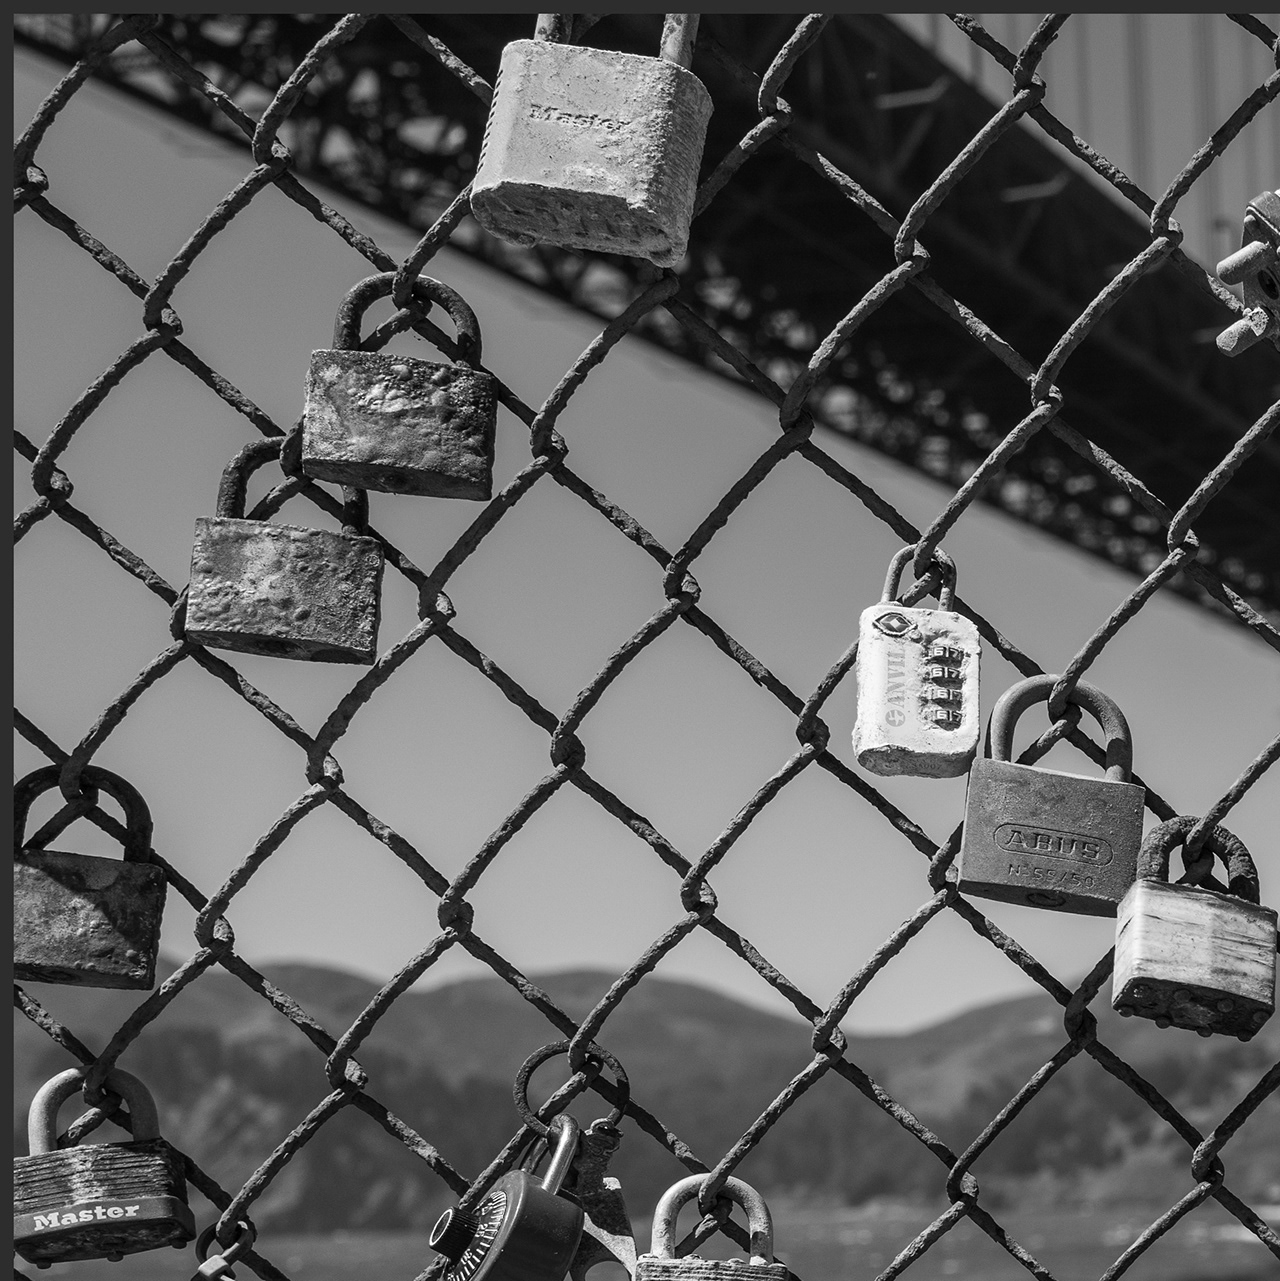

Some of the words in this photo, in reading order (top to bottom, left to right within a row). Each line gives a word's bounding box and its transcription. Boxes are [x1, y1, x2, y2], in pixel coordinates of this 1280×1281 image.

[529, 103, 632, 131] Master
[1005, 829, 1101, 860] ABUS
[33, 1205, 140, 1231] Master
